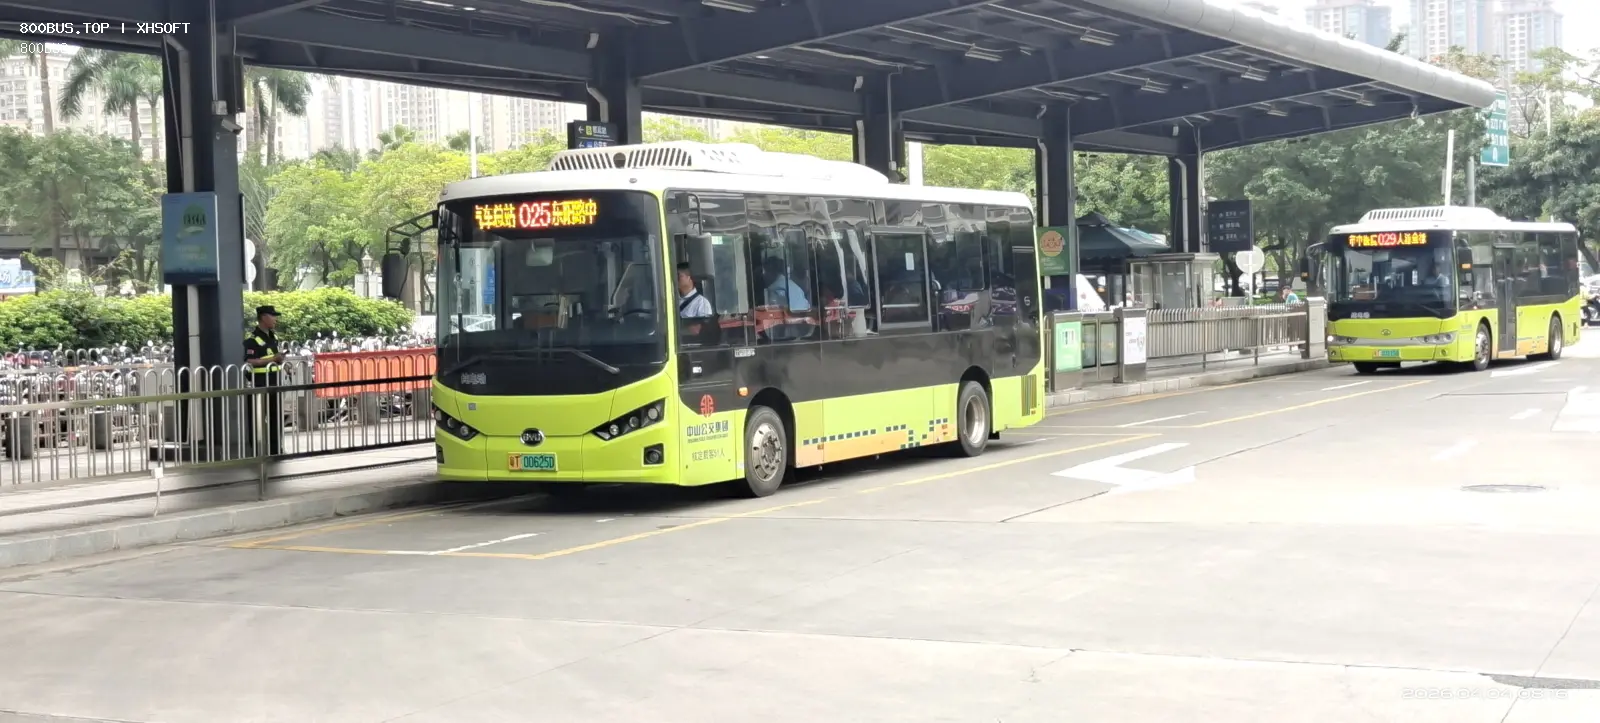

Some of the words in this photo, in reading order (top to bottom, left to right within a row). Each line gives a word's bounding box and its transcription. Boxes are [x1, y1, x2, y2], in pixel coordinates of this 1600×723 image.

[519, 202, 551, 228] 025
[1378, 232, 1396, 246] 029
[687, 420, 729, 437] 中山公交集团
